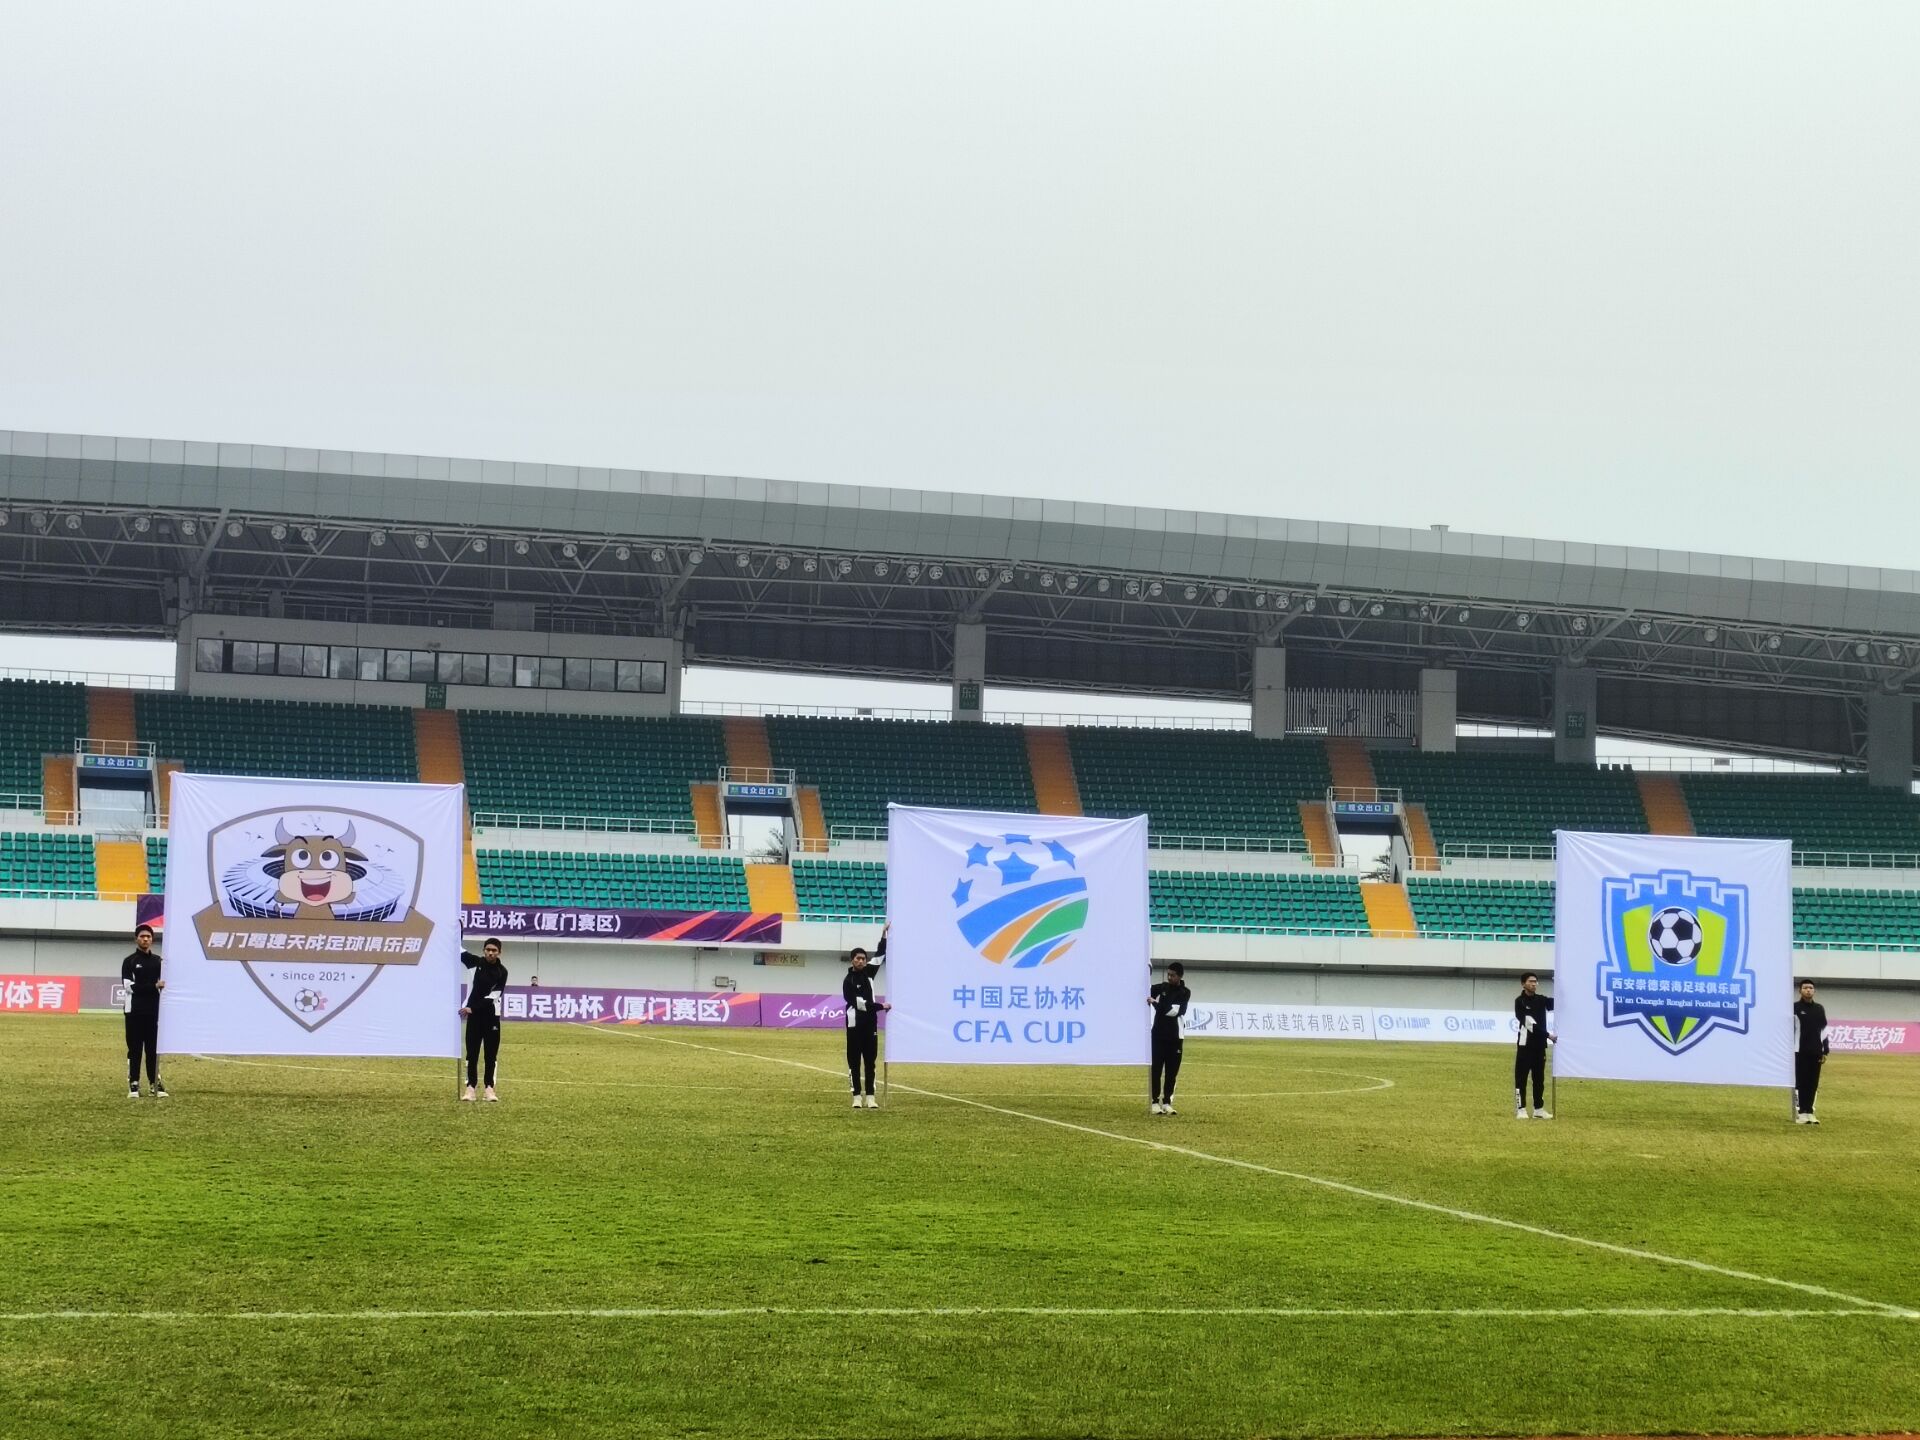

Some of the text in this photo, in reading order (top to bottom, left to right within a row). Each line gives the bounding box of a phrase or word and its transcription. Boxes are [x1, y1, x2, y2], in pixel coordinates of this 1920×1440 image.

[97, 757, 134, 767] 观众出口
[740, 786, 775, 795] 观众出口
[1348, 803, 1382, 812] 观众出口
[282, 971, 346, 982] since 2021
[0, 980, 65, 1009] 体育
[953, 984, 1085, 1010] 中国足协杯
[779, 1002, 844, 1020] Game for
[1216, 1010, 1365, 1033] 厦门天成建筑有限公司
[953, 1020, 1086, 1043] CFA CUP
